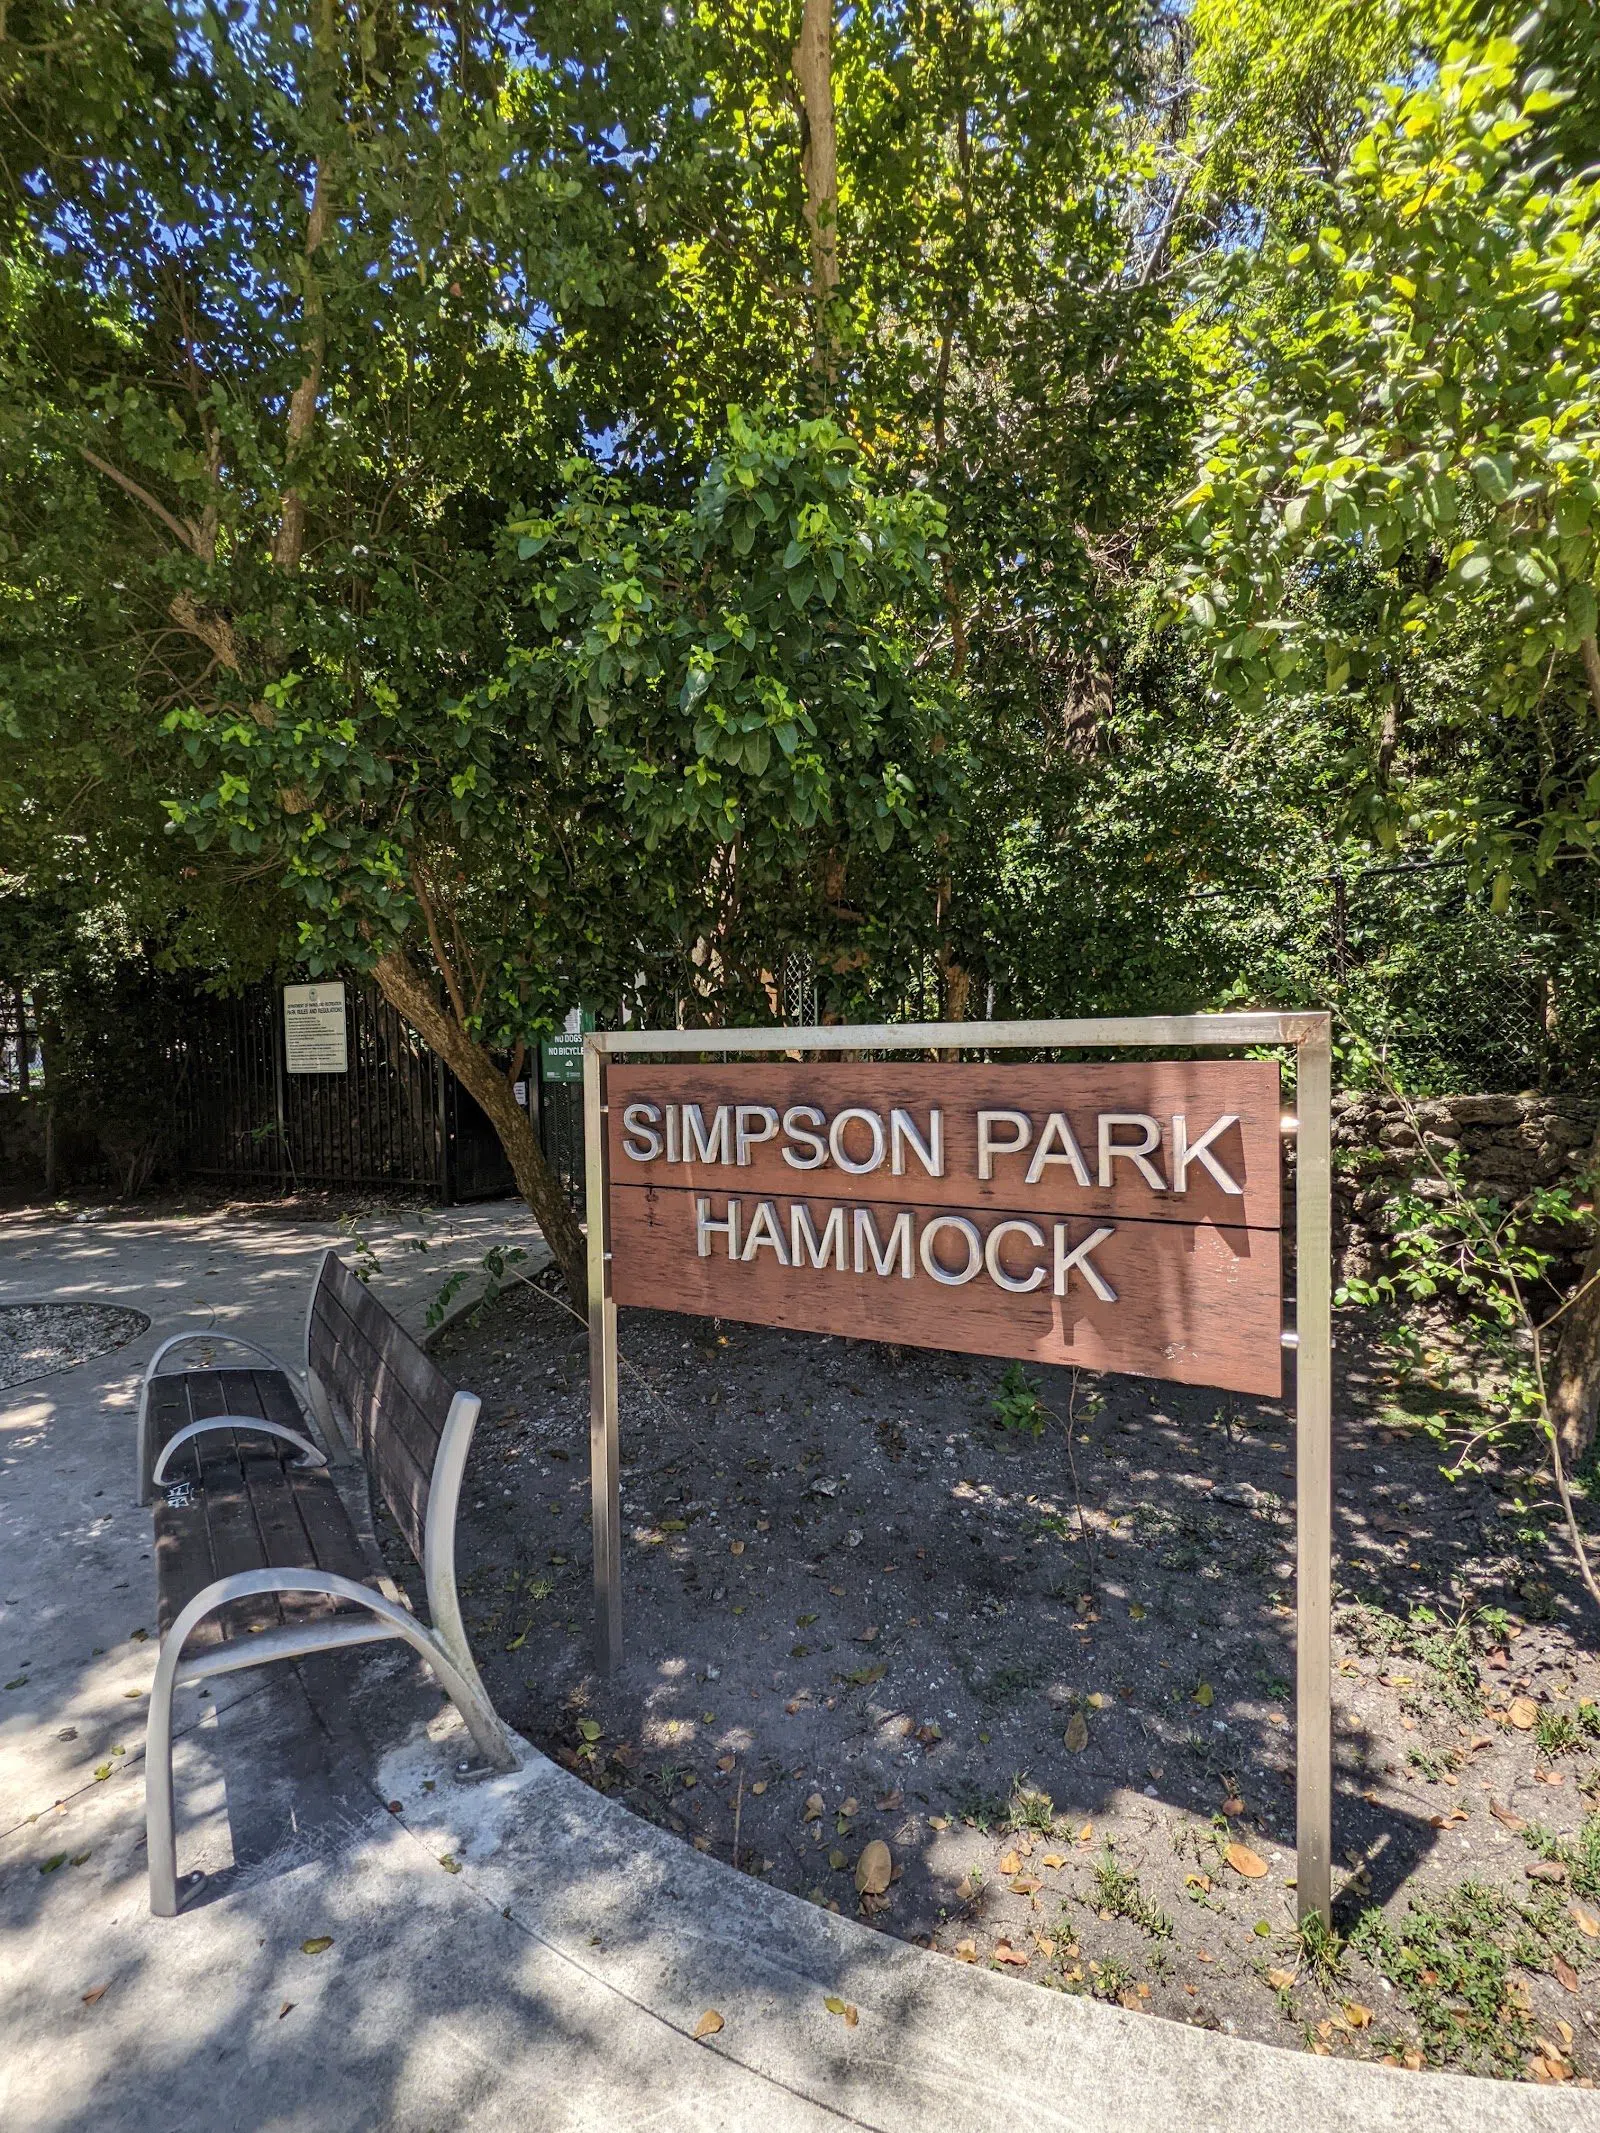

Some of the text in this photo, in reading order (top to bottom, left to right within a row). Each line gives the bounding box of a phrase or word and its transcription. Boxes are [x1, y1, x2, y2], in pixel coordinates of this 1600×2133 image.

[548, 1046, 584, 1056] NO BICYCLE
[554, 1034, 582, 1043] NO DOGS
[622, 1103, 1243, 1195] SIMPSON PARK
[696, 1198, 1118, 1302] HAMMOCK
